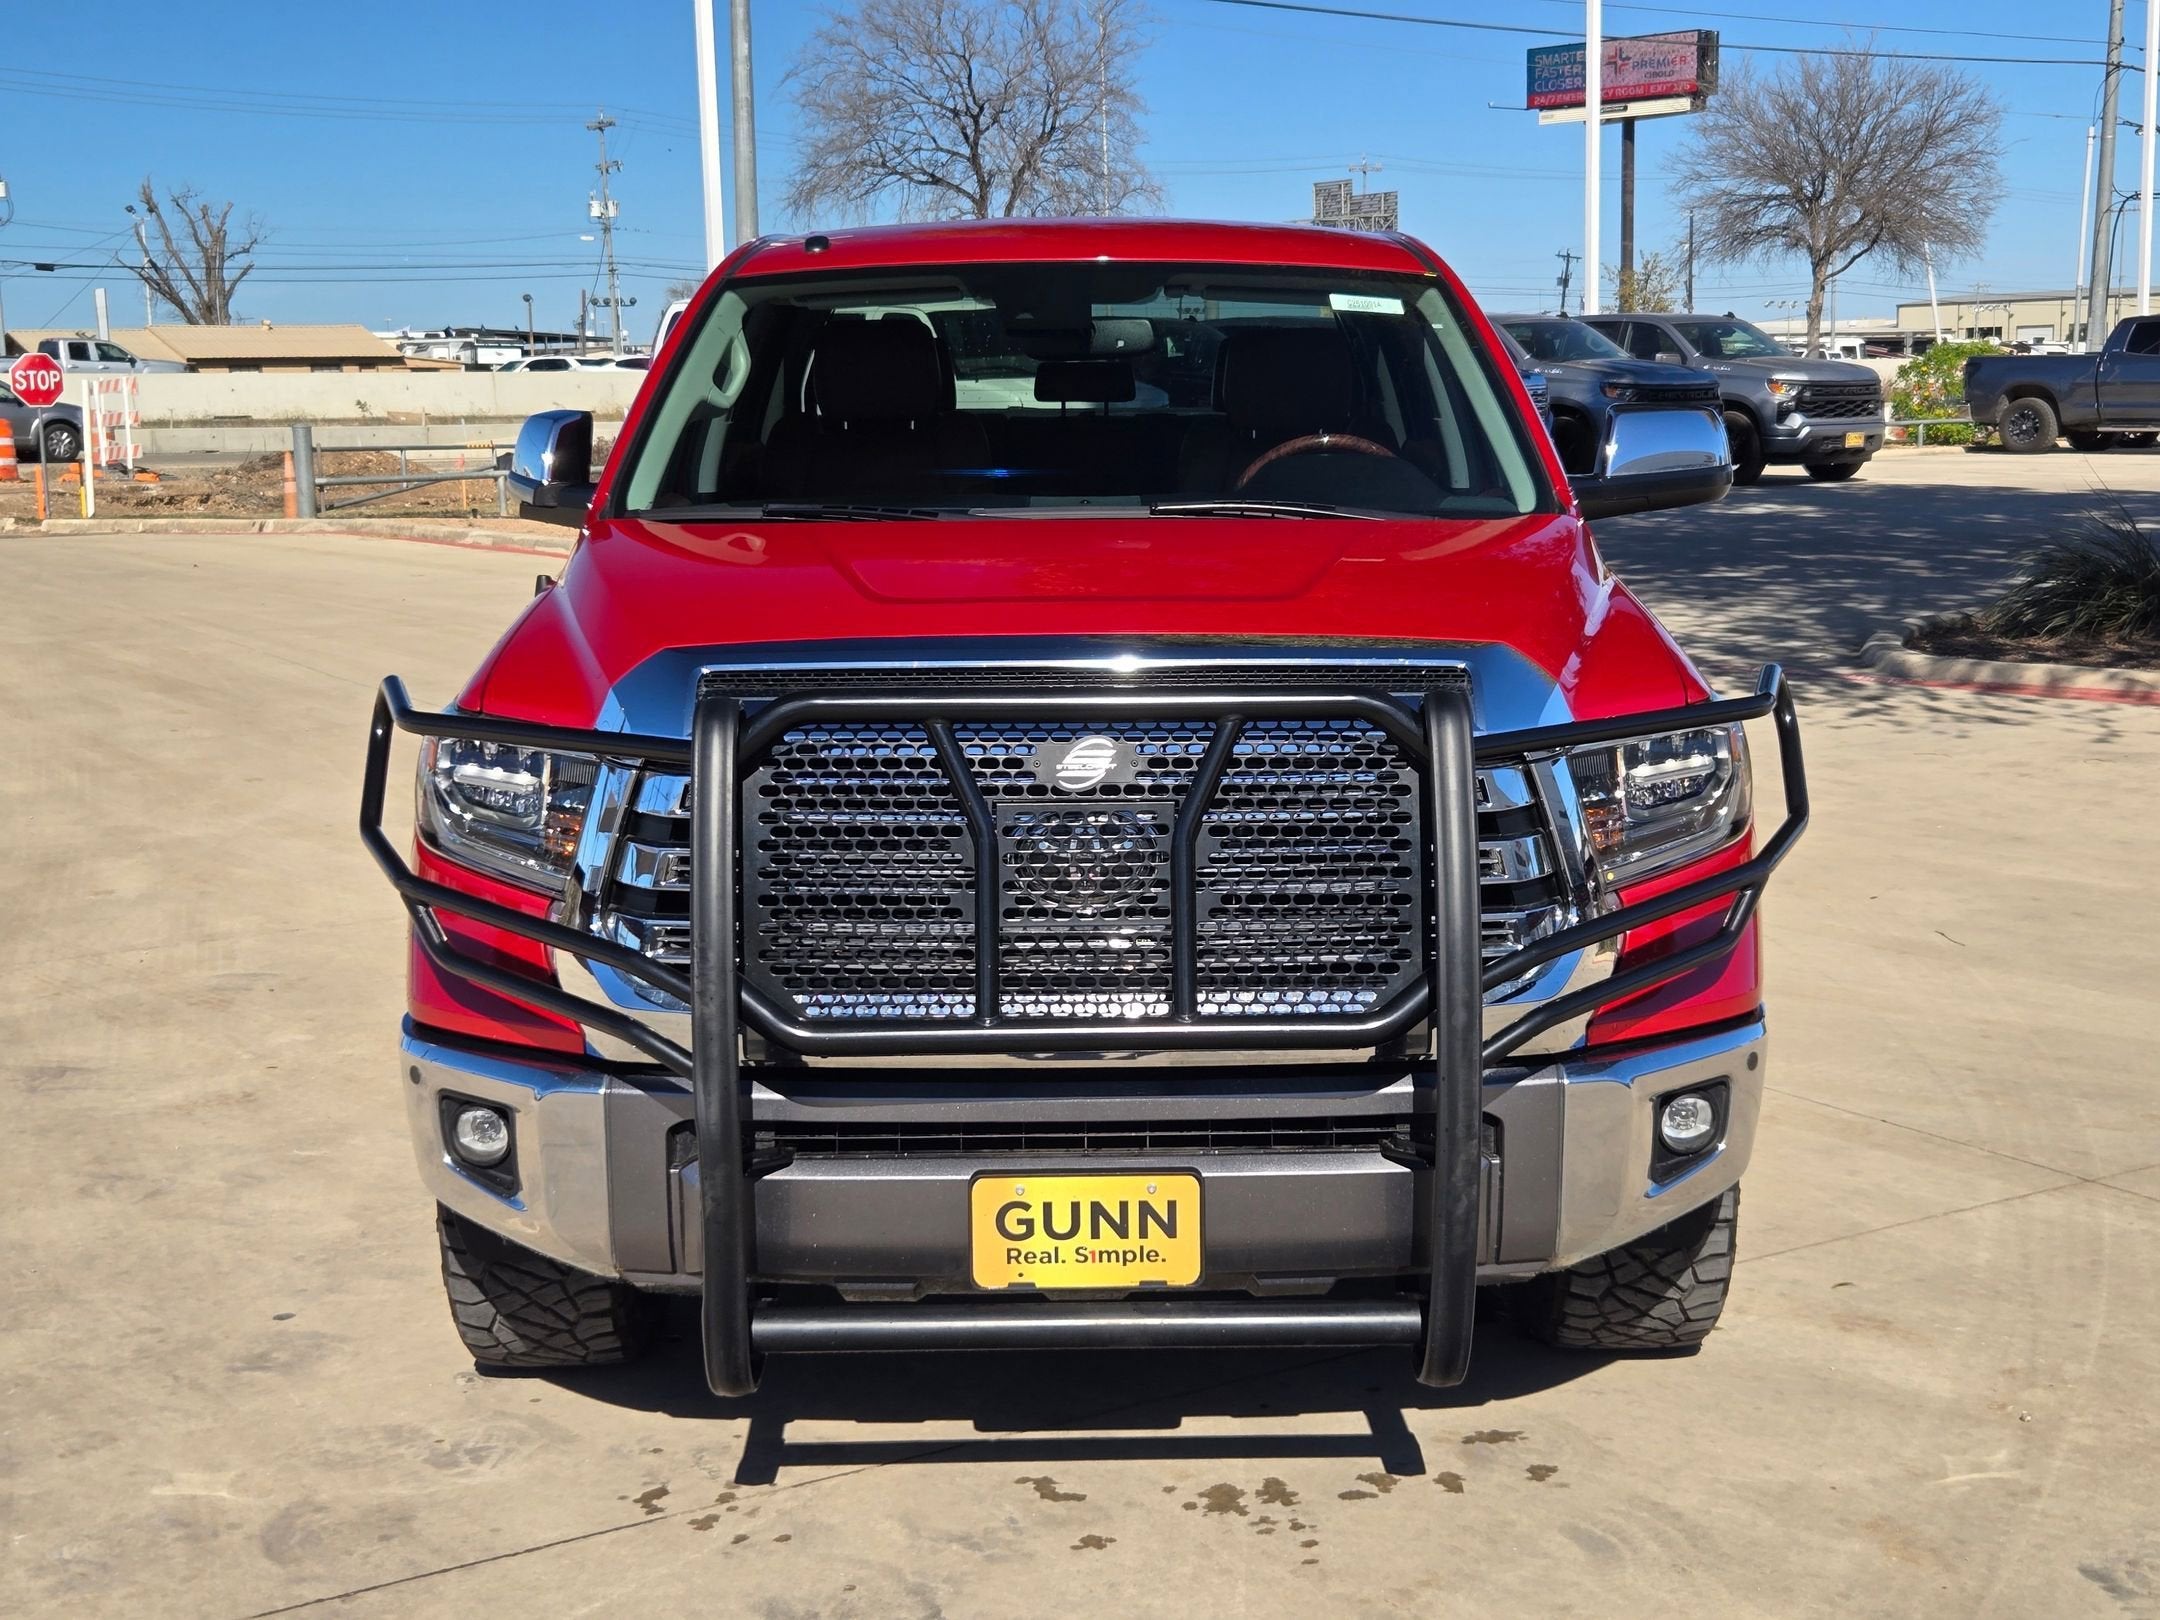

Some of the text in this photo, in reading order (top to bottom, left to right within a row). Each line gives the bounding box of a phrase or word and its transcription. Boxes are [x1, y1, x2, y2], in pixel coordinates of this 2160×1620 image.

[1535, 51, 1585, 67] SMARTE
[1632, 55, 1687, 70] PREMIER
[1534, 76, 1585, 92] CLOSER.
[1615, 86, 1644, 96] ROOM
[15, 370, 61, 391] STOP
[995, 1199, 1178, 1242] GUNN
[1006, 1246, 1067, 1265] Real.
